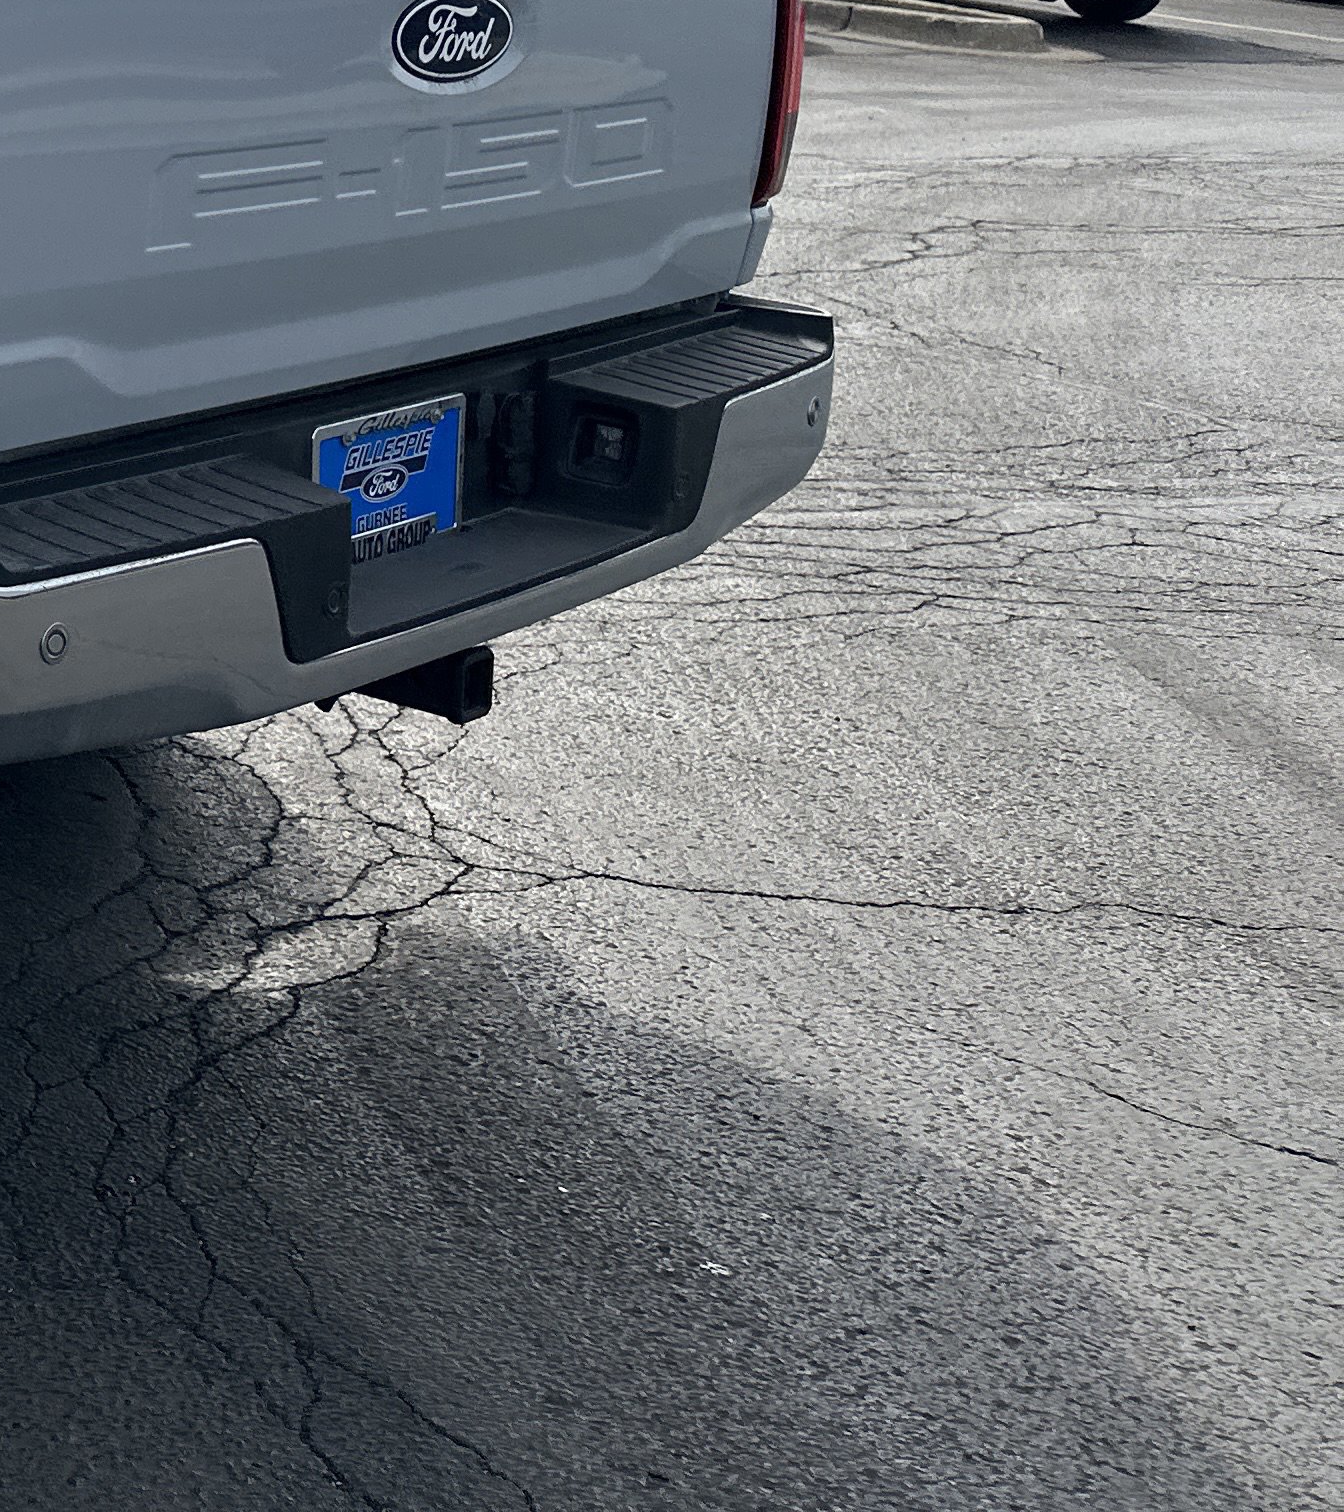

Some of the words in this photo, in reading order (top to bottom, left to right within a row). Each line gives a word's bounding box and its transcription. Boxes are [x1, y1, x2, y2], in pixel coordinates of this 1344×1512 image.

[418, 3, 495, 64] Ford
[145, 96, 677, 252] F-150
[344, 427, 435, 472] GILLESPIE
[368, 470, 399, 497] Ford
[356, 503, 408, 534] GURNEE
[387, 518, 431, 554] GROUP
